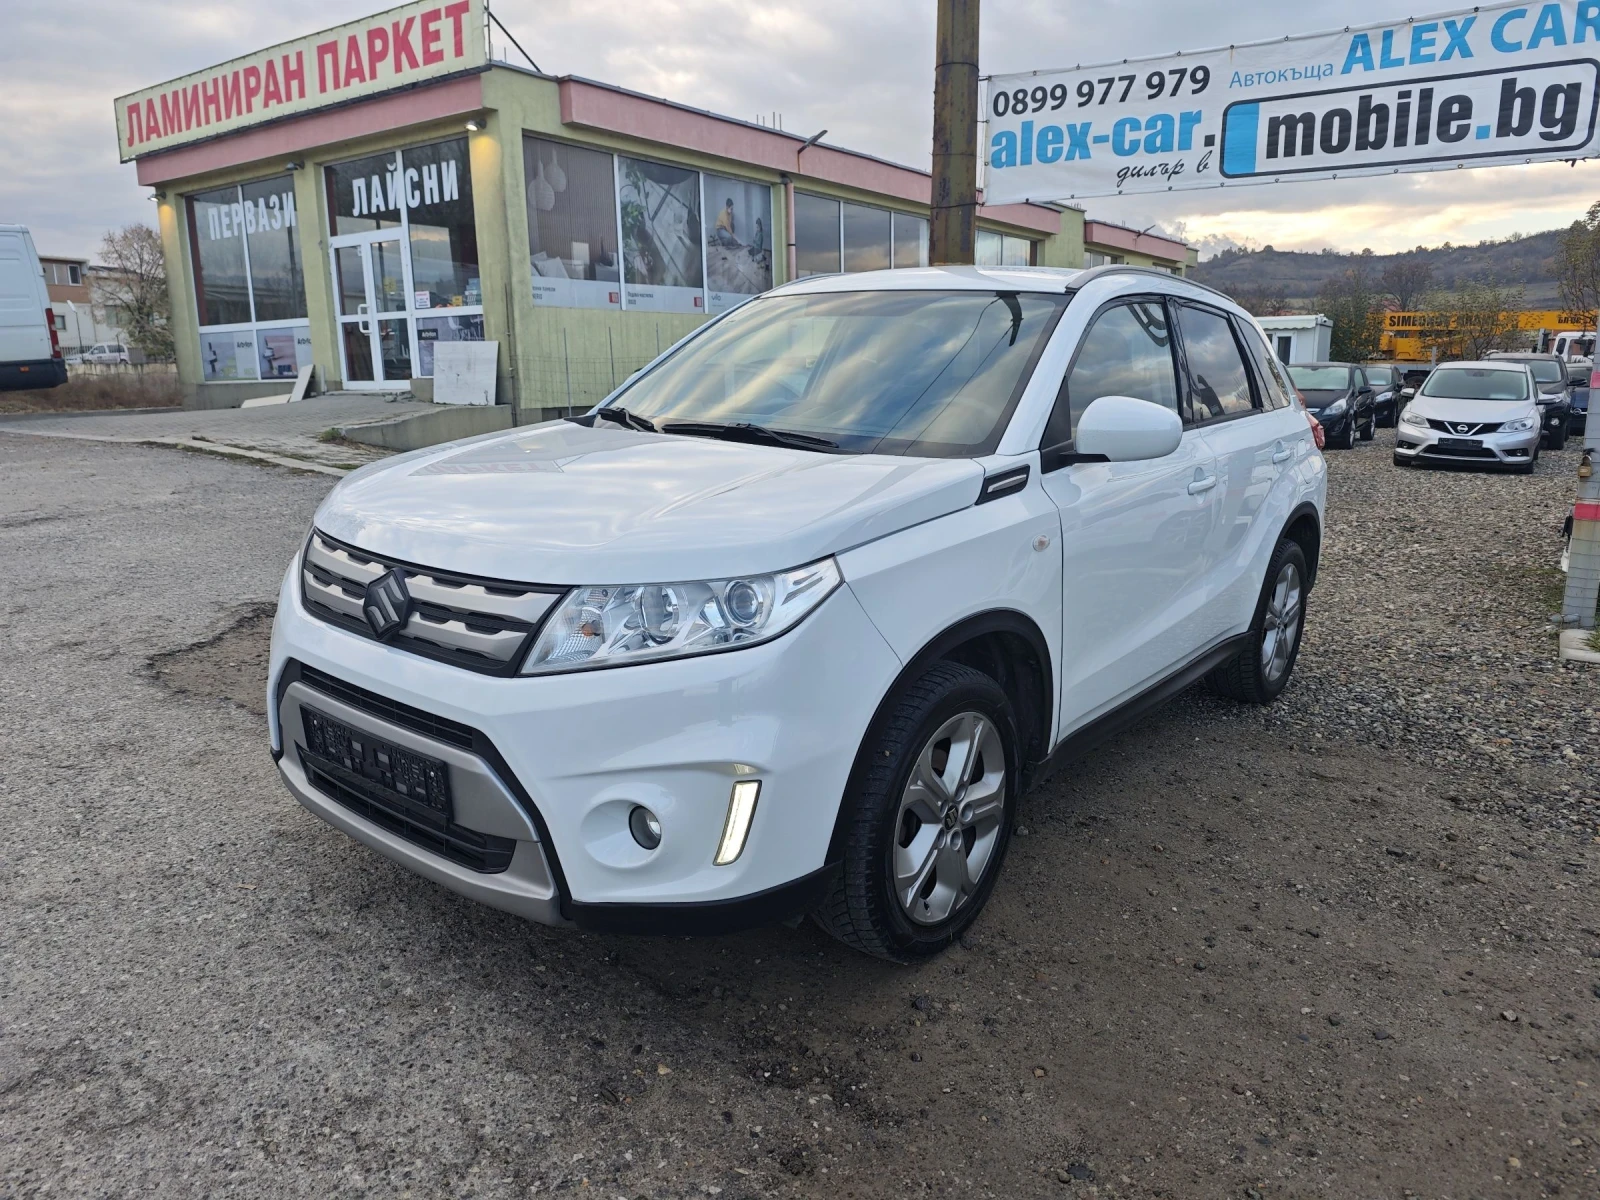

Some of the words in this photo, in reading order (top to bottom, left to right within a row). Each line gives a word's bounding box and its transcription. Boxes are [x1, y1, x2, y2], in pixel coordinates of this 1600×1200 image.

[126, 51, 306, 147] ЛАМИНИРАН
[316, 0, 471, 94] ПАРКЕТ
[1229, 62, 1335, 90] Автокъща
[1341, 17, 1478, 76] ALEX
[1489, 0, 1600, 53] CAR
[992, 84, 1068, 117] 0899
[1076, 75, 1137, 108] 977
[1145, 65, 1211, 99] 979
[1265, 78, 1584, 160] mobile.bg
[351, 158, 460, 217] ЛАЙСНИ
[1116, 161, 1184, 188] дилър
[208, 191, 296, 241] ПЕРВАЗИ
